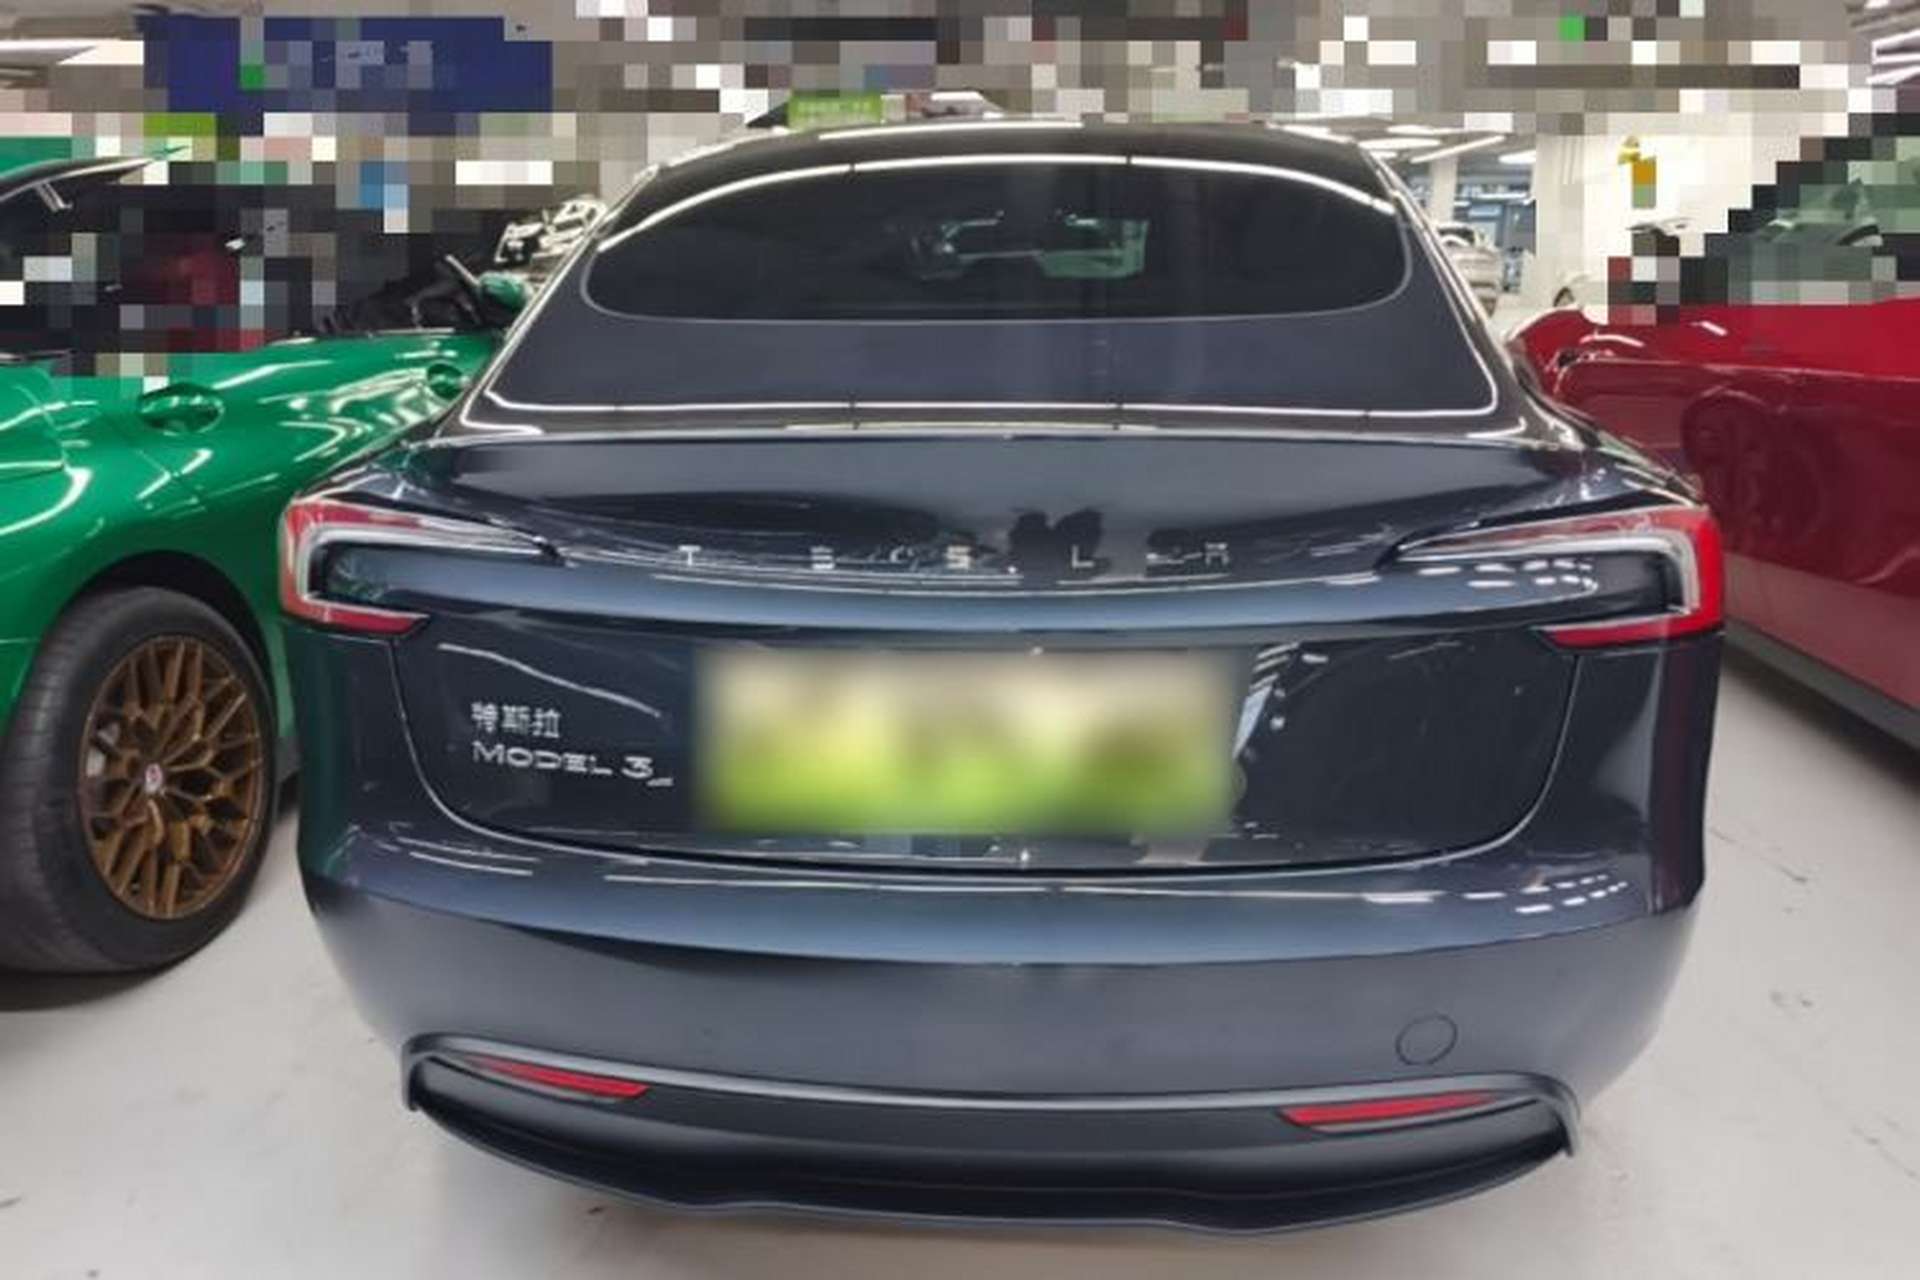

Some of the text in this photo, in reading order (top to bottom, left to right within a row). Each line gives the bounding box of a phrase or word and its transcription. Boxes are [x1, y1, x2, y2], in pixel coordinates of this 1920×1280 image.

[678, 542, 1230, 571] TESLA
[471, 701, 561, 738] 特斯拉
[472, 740, 653, 779] MODEL 3
